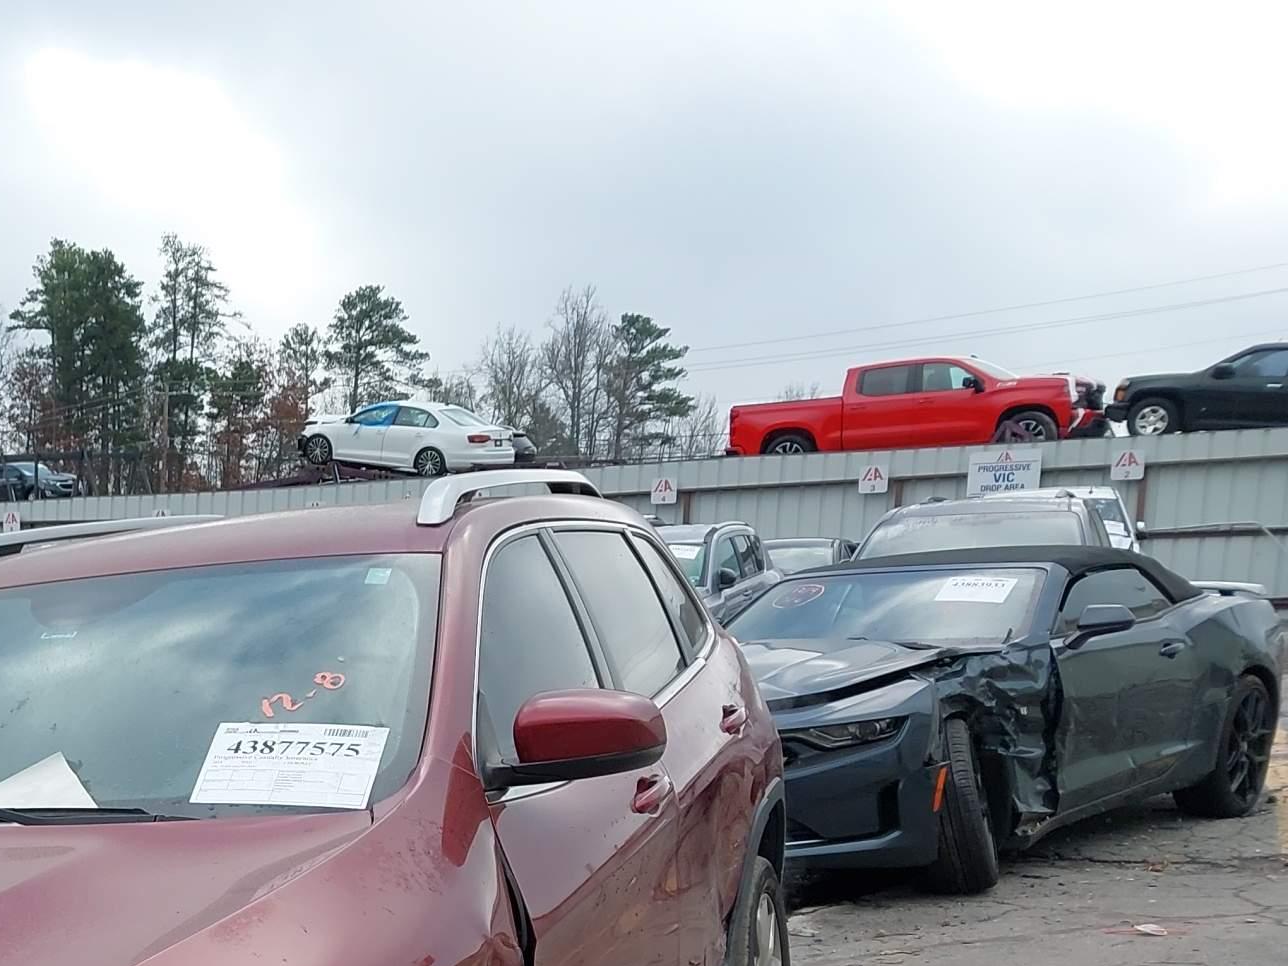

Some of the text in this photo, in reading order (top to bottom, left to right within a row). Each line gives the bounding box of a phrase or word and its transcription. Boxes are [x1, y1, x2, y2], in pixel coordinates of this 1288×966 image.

[977, 463, 1032, 473] PROGRESSIVE
[993, 472, 1016, 483] VIC
[980, 483, 1025, 492] DROP AREA
[226, 739, 363, 757] 43877575
